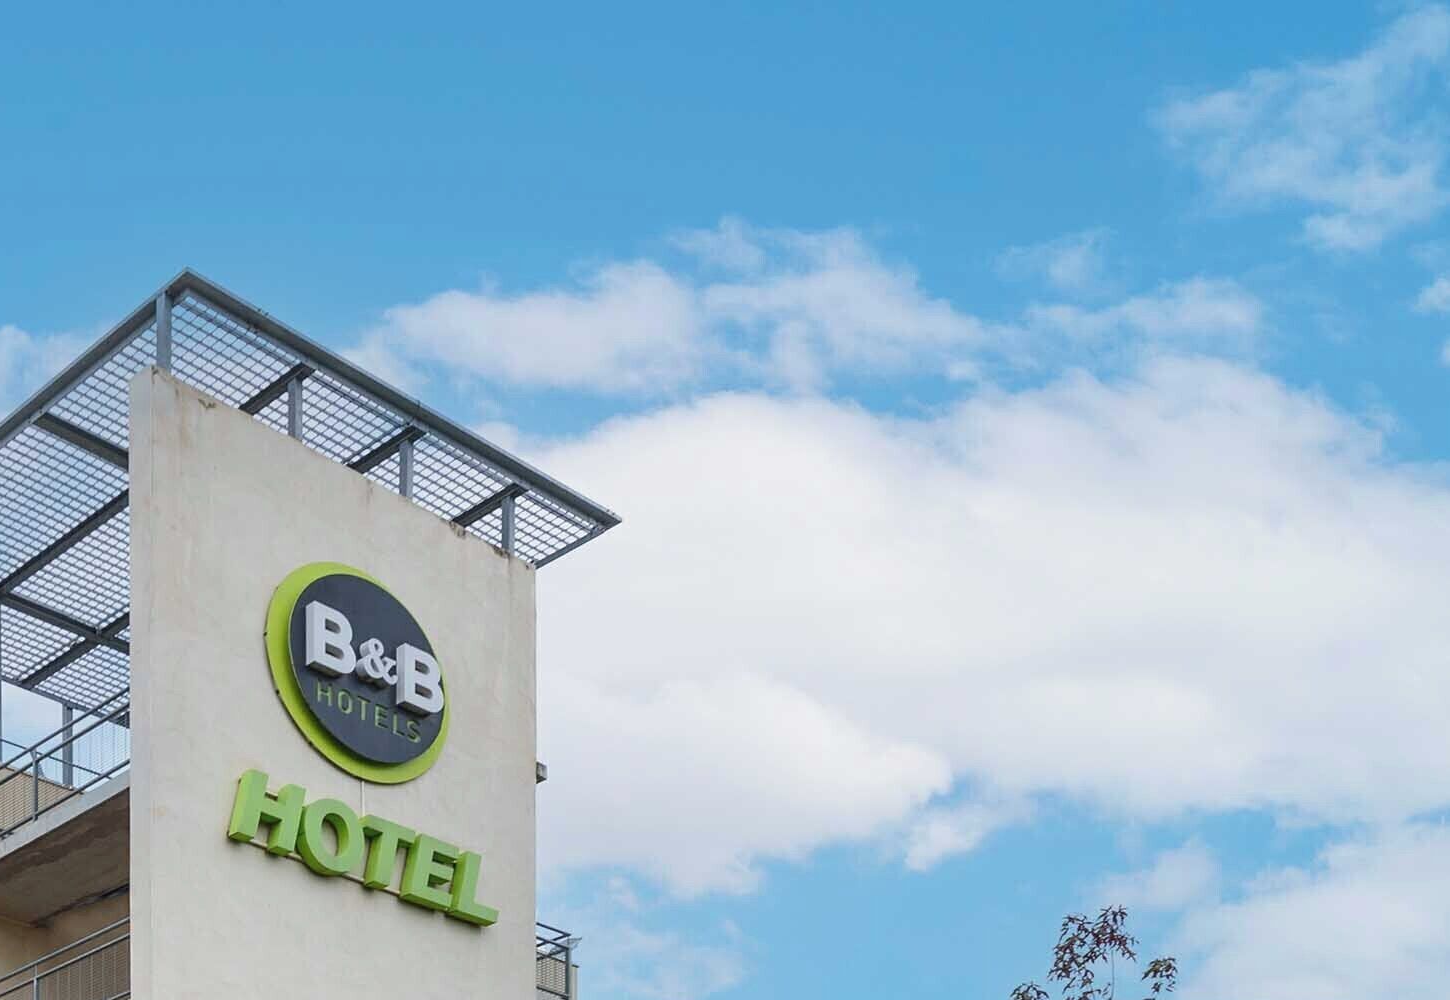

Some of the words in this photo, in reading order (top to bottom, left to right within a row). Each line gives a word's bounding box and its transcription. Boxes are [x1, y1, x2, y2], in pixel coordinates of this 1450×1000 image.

[305, 600, 445, 714] B&B
[316, 679, 421, 743] HOTELS
[228, 769, 499, 927] HOTEL
